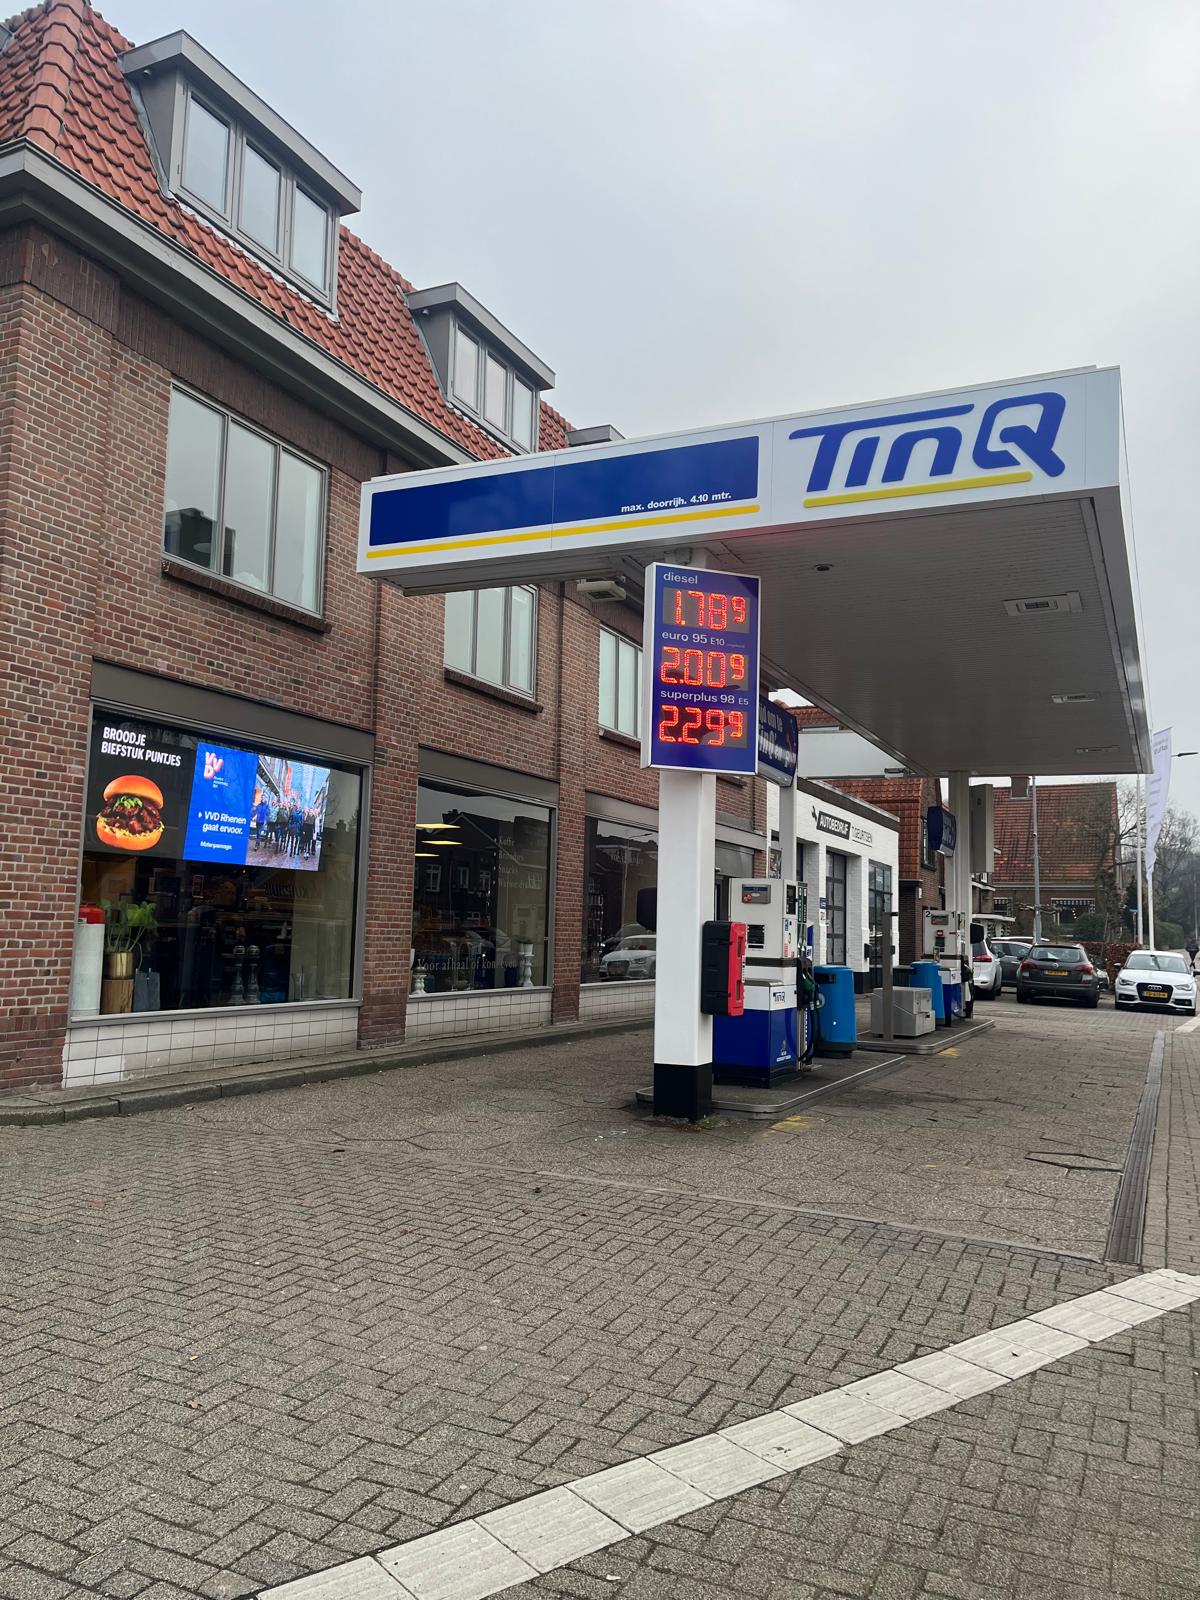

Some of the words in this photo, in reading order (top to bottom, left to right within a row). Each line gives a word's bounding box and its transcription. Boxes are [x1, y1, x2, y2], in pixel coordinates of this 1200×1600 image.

[789, 392, 1066, 493] TinQ
[621, 504, 645, 513] max.
[647, 497, 687, 509] doorrijh.
[690, 493, 708, 503] 4.10
[711, 491, 732, 501] mtr.
[663, 571, 698, 585] diesel
[661, 631, 689, 642] euro
[692, 633, 708, 644] 95
[710, 637, 725, 646] E10
[660, 646, 745, 688] 2.009
[660, 689, 718, 703] superplus
[719, 694, 735, 704] 98
[738, 697, 749, 706] E5
[659, 704, 744, 746] 2.299
[103, 726, 147, 747] BROODJE
[101, 741, 144, 760] BIEFSTUK
[145, 749, 182, 767] PUNTJES
[204, 810, 220, 822] VVD
[220, 813, 247, 825] Rhenen
[819, 814, 849, 836] AUTOBEDRIJF
[202, 822, 219, 833] gaat
[219, 824, 243, 835] ervoor.
[925, 910, 931, 918] 2
